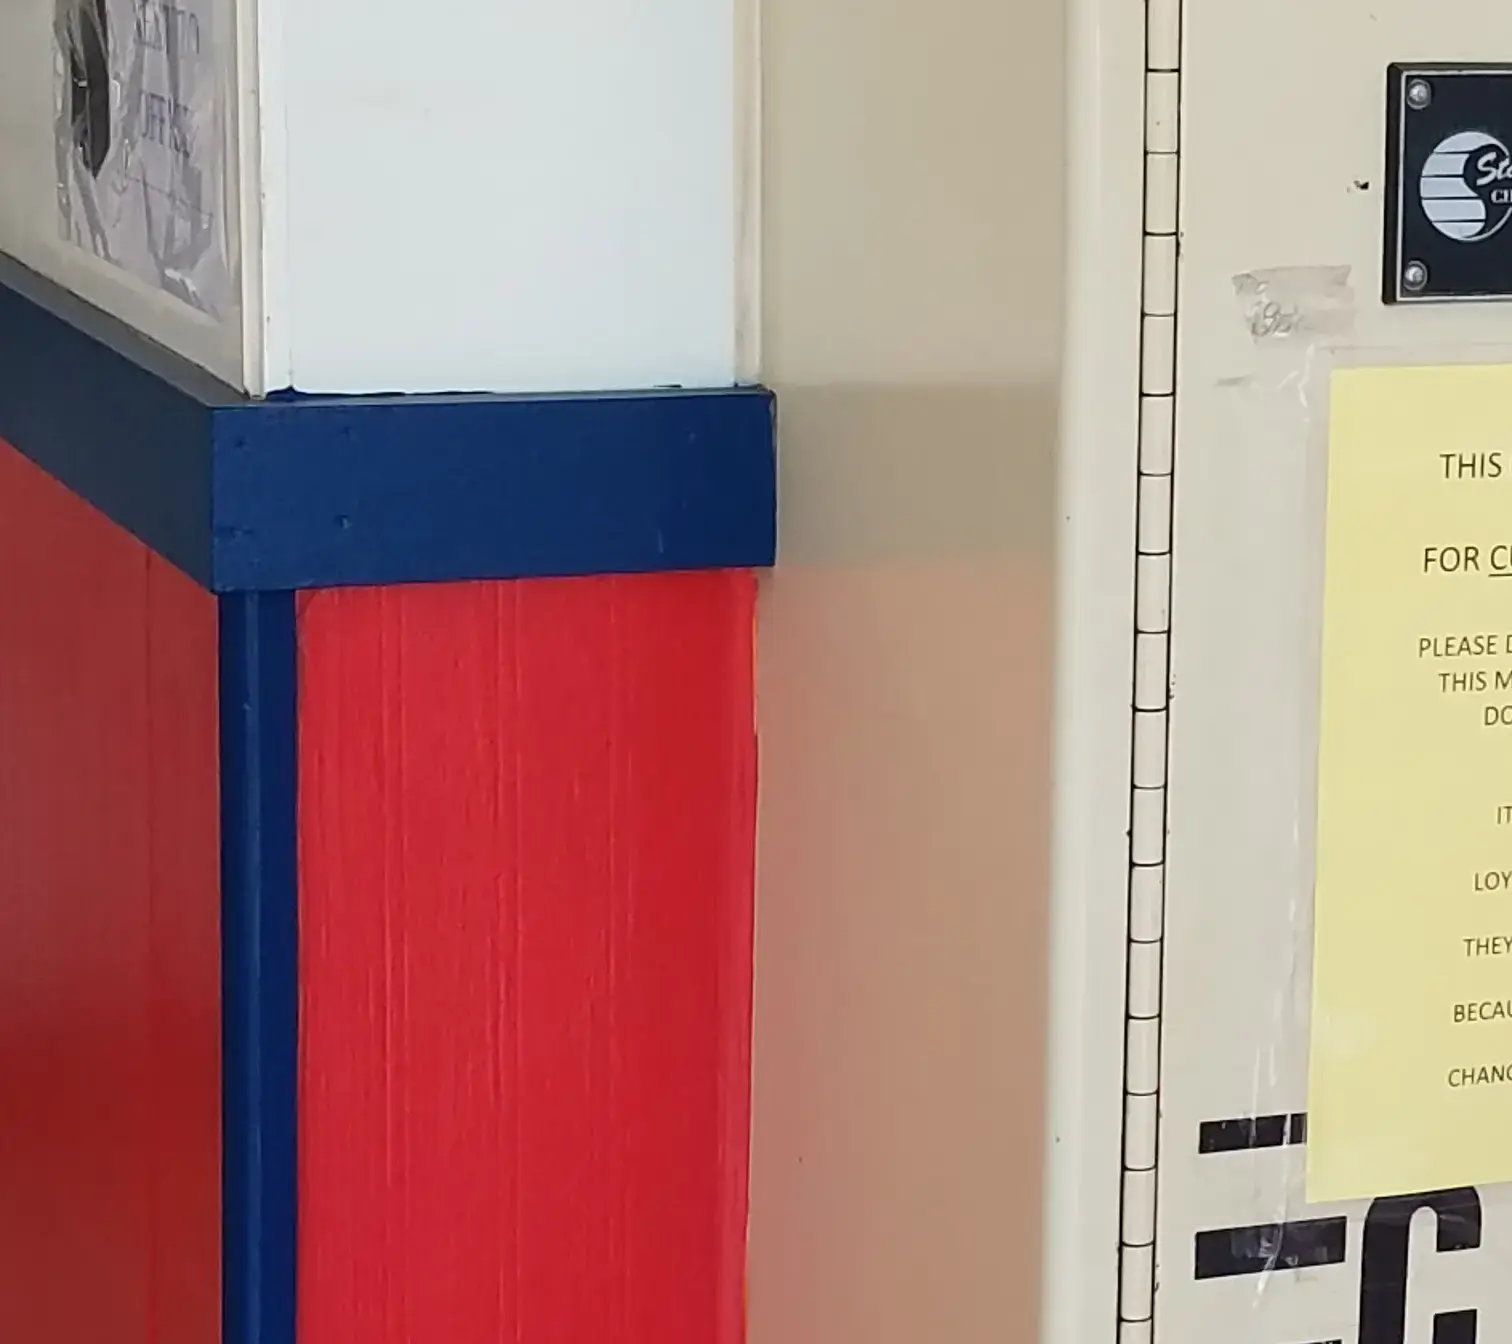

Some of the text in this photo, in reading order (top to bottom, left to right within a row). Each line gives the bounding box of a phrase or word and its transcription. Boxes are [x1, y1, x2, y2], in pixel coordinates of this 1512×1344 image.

[1440, 452, 1502, 479] THIS
[1423, 546, 1480, 573] FOR
[1419, 634, 1498, 658] PLEASE
[1438, 671, 1487, 693] THIS
